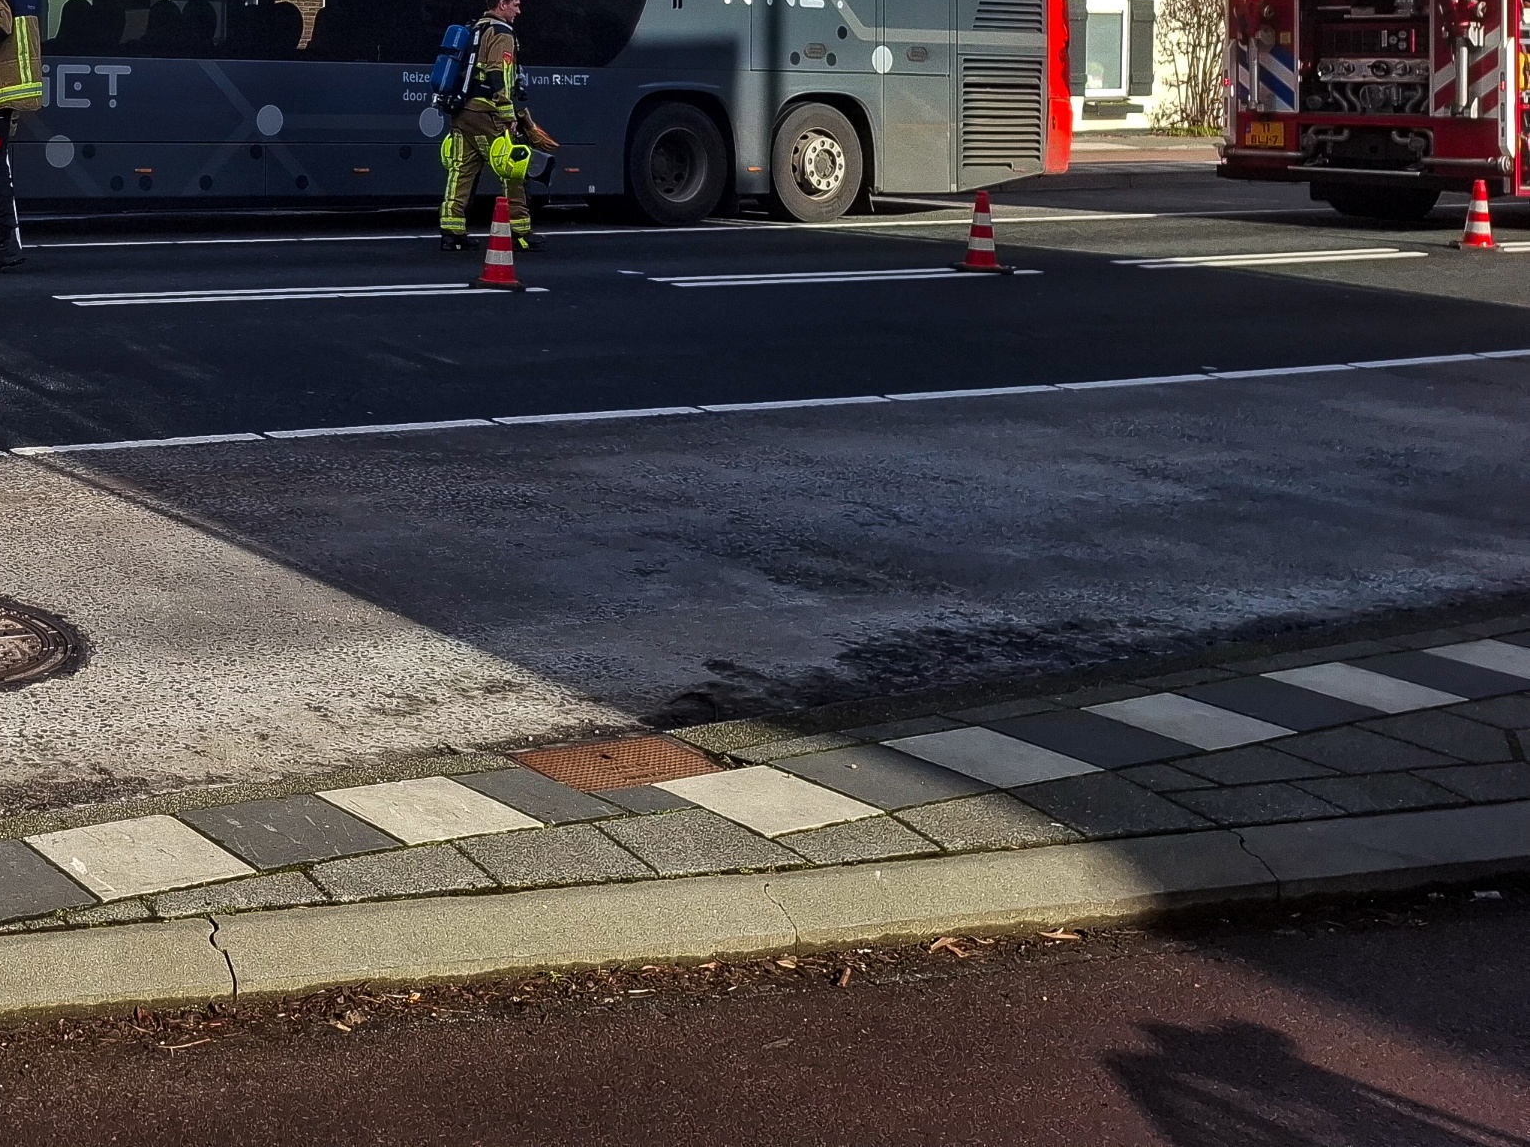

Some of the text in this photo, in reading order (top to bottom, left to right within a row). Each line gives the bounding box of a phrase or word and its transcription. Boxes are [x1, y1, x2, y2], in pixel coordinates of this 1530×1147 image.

[402, 71, 431, 83] Reize
[531, 75, 550, 85] van
[402, 89, 428, 101] door
